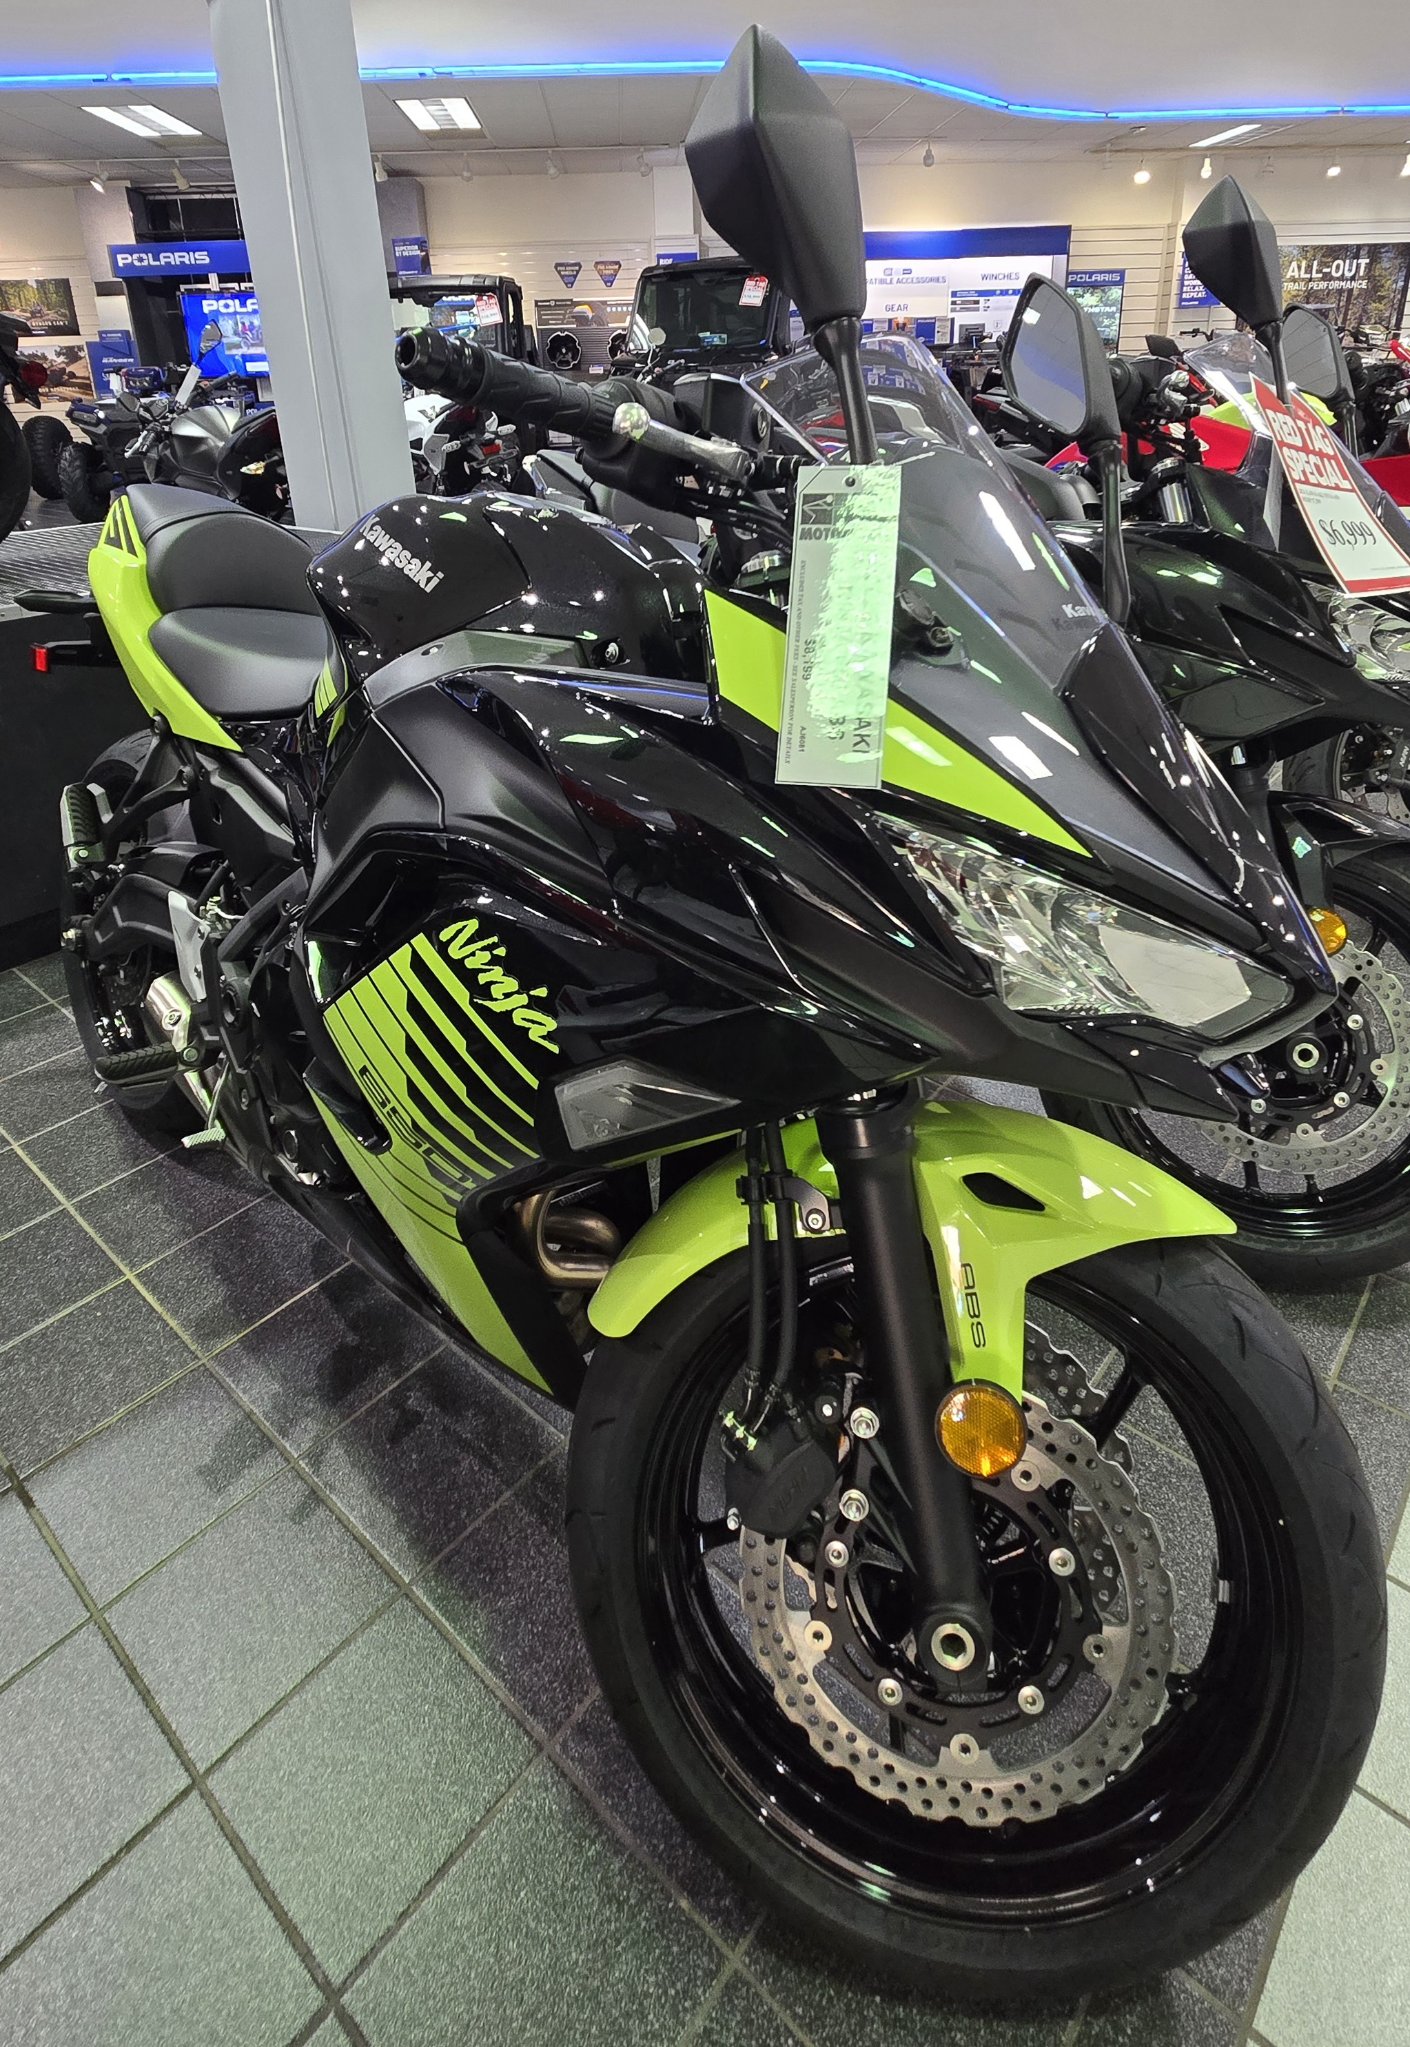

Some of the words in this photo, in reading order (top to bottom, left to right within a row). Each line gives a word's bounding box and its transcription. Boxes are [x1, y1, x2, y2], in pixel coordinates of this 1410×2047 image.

[116, 251, 210, 267] POLARIS
[981, 272, 1020, 281] WINCHES
[1068, 273, 1121, 282] POLARIS
[1286, 258, 1370, 279] ALL-OUT
[896, 276, 947, 285] ACCESSORIES
[1283, 282, 1306, 290] TRAIL
[1308, 280, 1368, 290] PERFORMANCE
[202, 299, 259, 314] POLA
[885, 304, 909, 312] GEAR
[1265, 409, 1303, 447] RED
[1298, 420, 1335, 456] TAG
[1282, 446, 1350, 487] SPECIAL
[1318, 518, 1377, 551] $6,999
[360, 514, 445, 594] Kawasaki
[439, 918, 560, 1054] Ninja
[960, 1262, 986, 1349] ABS
